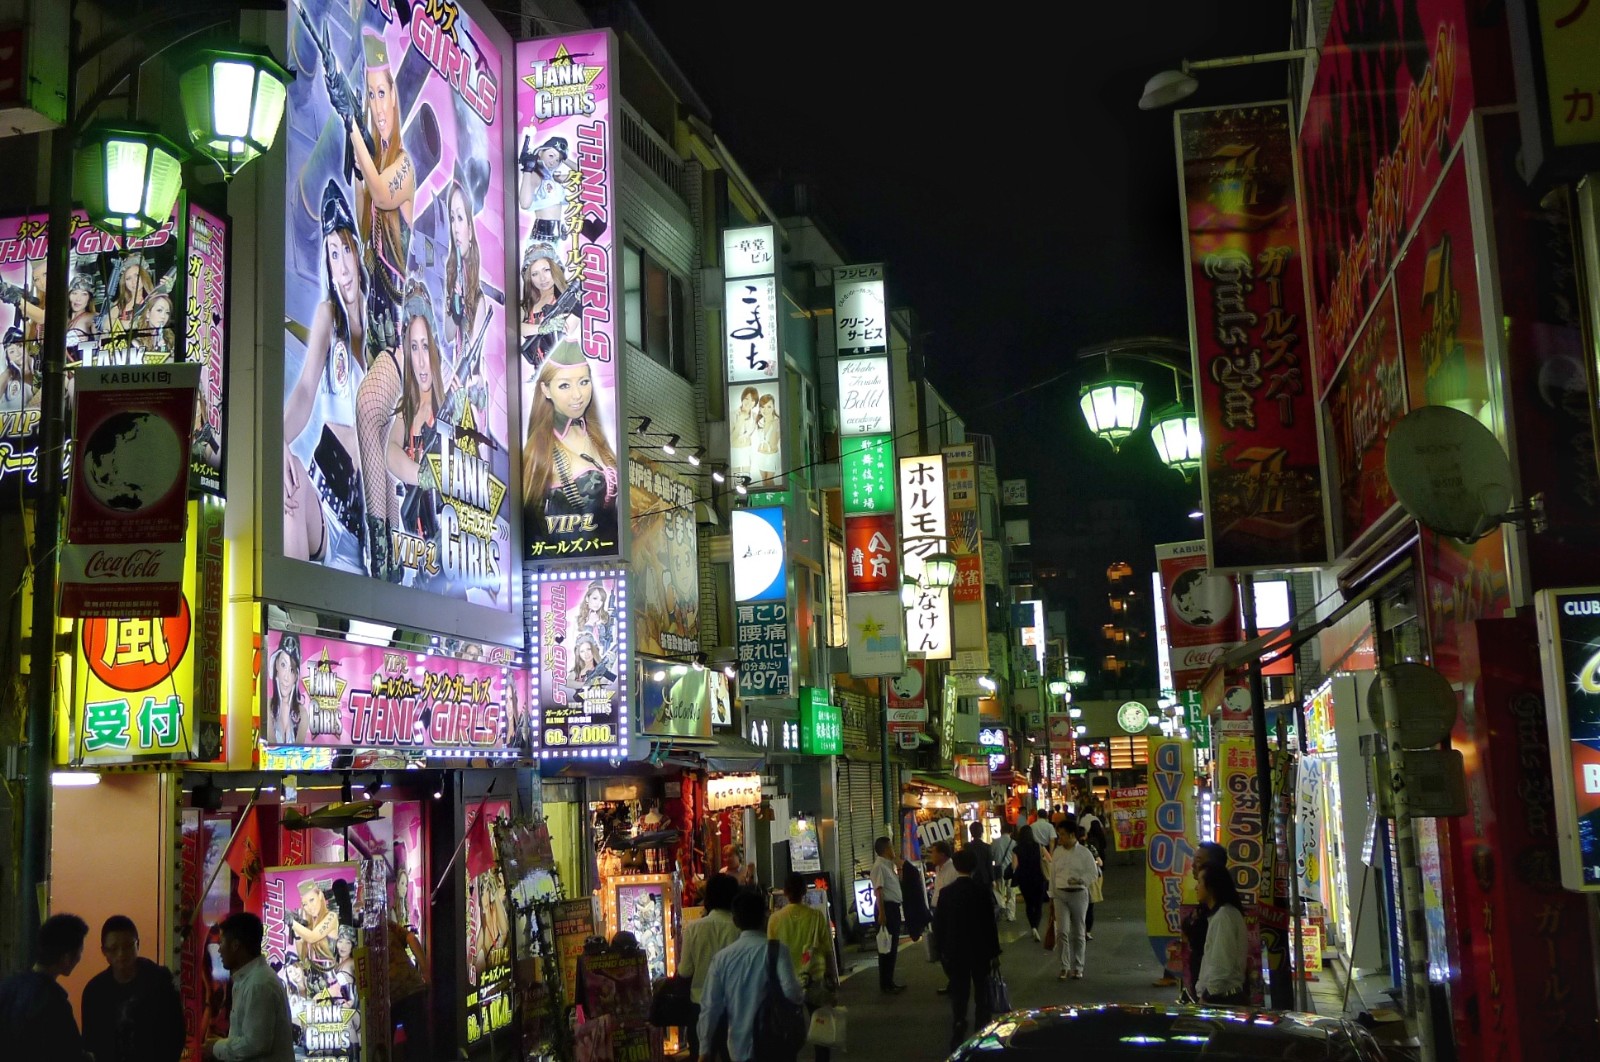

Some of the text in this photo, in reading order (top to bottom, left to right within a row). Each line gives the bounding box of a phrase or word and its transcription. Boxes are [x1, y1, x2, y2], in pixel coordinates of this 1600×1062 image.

[411, 6, 497, 126] GIRLS
[531, 59, 585, 88] TANK
[535, 90, 596, 119] GIRLS
[566, 170, 585, 283] タンクガールズ
[577, 121, 611, 362] TANK GIRLS
[751, 252, 773, 263] ビル
[839, 268, 878, 279] フジビル
[186, 255, 204, 362] ガールズバ
[839, 317, 874, 329] クリーン
[730, 285, 770, 371] こまち
[848, 328, 883, 341] サービス
[1257, 246, 1302, 426] ガールズバー
[843, 389, 884, 410] Ballet
[436, 418, 491, 512] TANK
[441, 504, 500, 586] GIRLS
[665, 512, 695, 549] こまち
[531, 538, 614, 556] ガールズバー
[868, 531, 891, 577] 八方
[85, 549, 166, 579] Coca-Cola
[851, 547, 864, 577] 寿司
[737, 604, 786, 624] 肩こり
[738, 624, 786, 641] 腰痛
[739, 642, 788, 661] 疲れに!
[740, 661, 782, 671] 10分あたり
[307, 660, 338, 699] TANK
[422, 672, 492, 703] タンクガールズ
[582, 685, 608, 699] TANK
[740, 670, 789, 690] 497円
[308, 701, 343, 737] GIRLS
[350, 689, 499, 746] TANK GIRLS
[545, 709, 582, 717] ガールズバー
[583, 700, 612, 715] GIRLS
[85, 695, 184, 751] 受付
[303, 1000, 342, 1024] TANK
[306, 1026, 350, 1050] GIRLS
